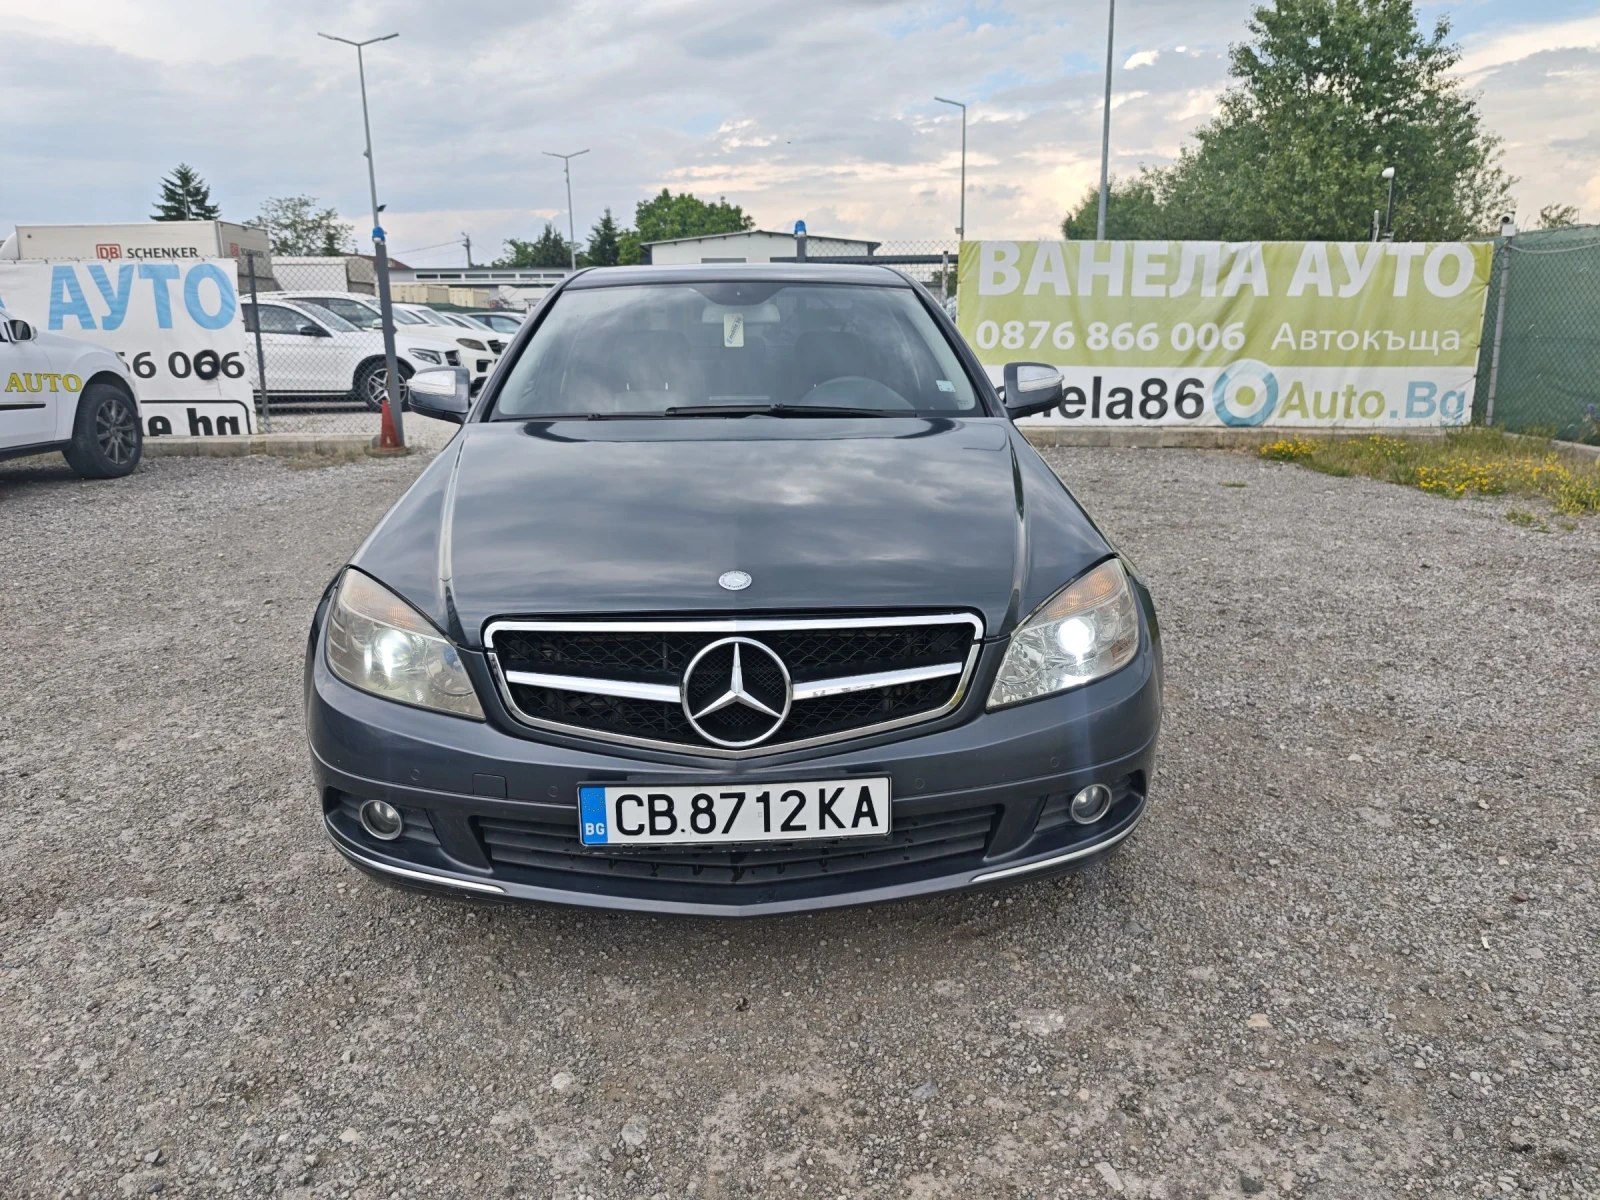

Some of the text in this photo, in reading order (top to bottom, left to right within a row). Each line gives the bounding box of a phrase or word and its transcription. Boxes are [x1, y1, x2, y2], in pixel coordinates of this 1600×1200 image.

[98, 246, 199, 259] DB SCHENKER
[978, 241, 1475, 298] ВАНЕЛА АУТО
[48, 263, 236, 330] АУТО
[976, 320, 1246, 351] 0876 866 006
[1270, 322, 1460, 356] Автокъща
[4, 372, 83, 392] AUTO
[585, 822, 605, 836] BG
